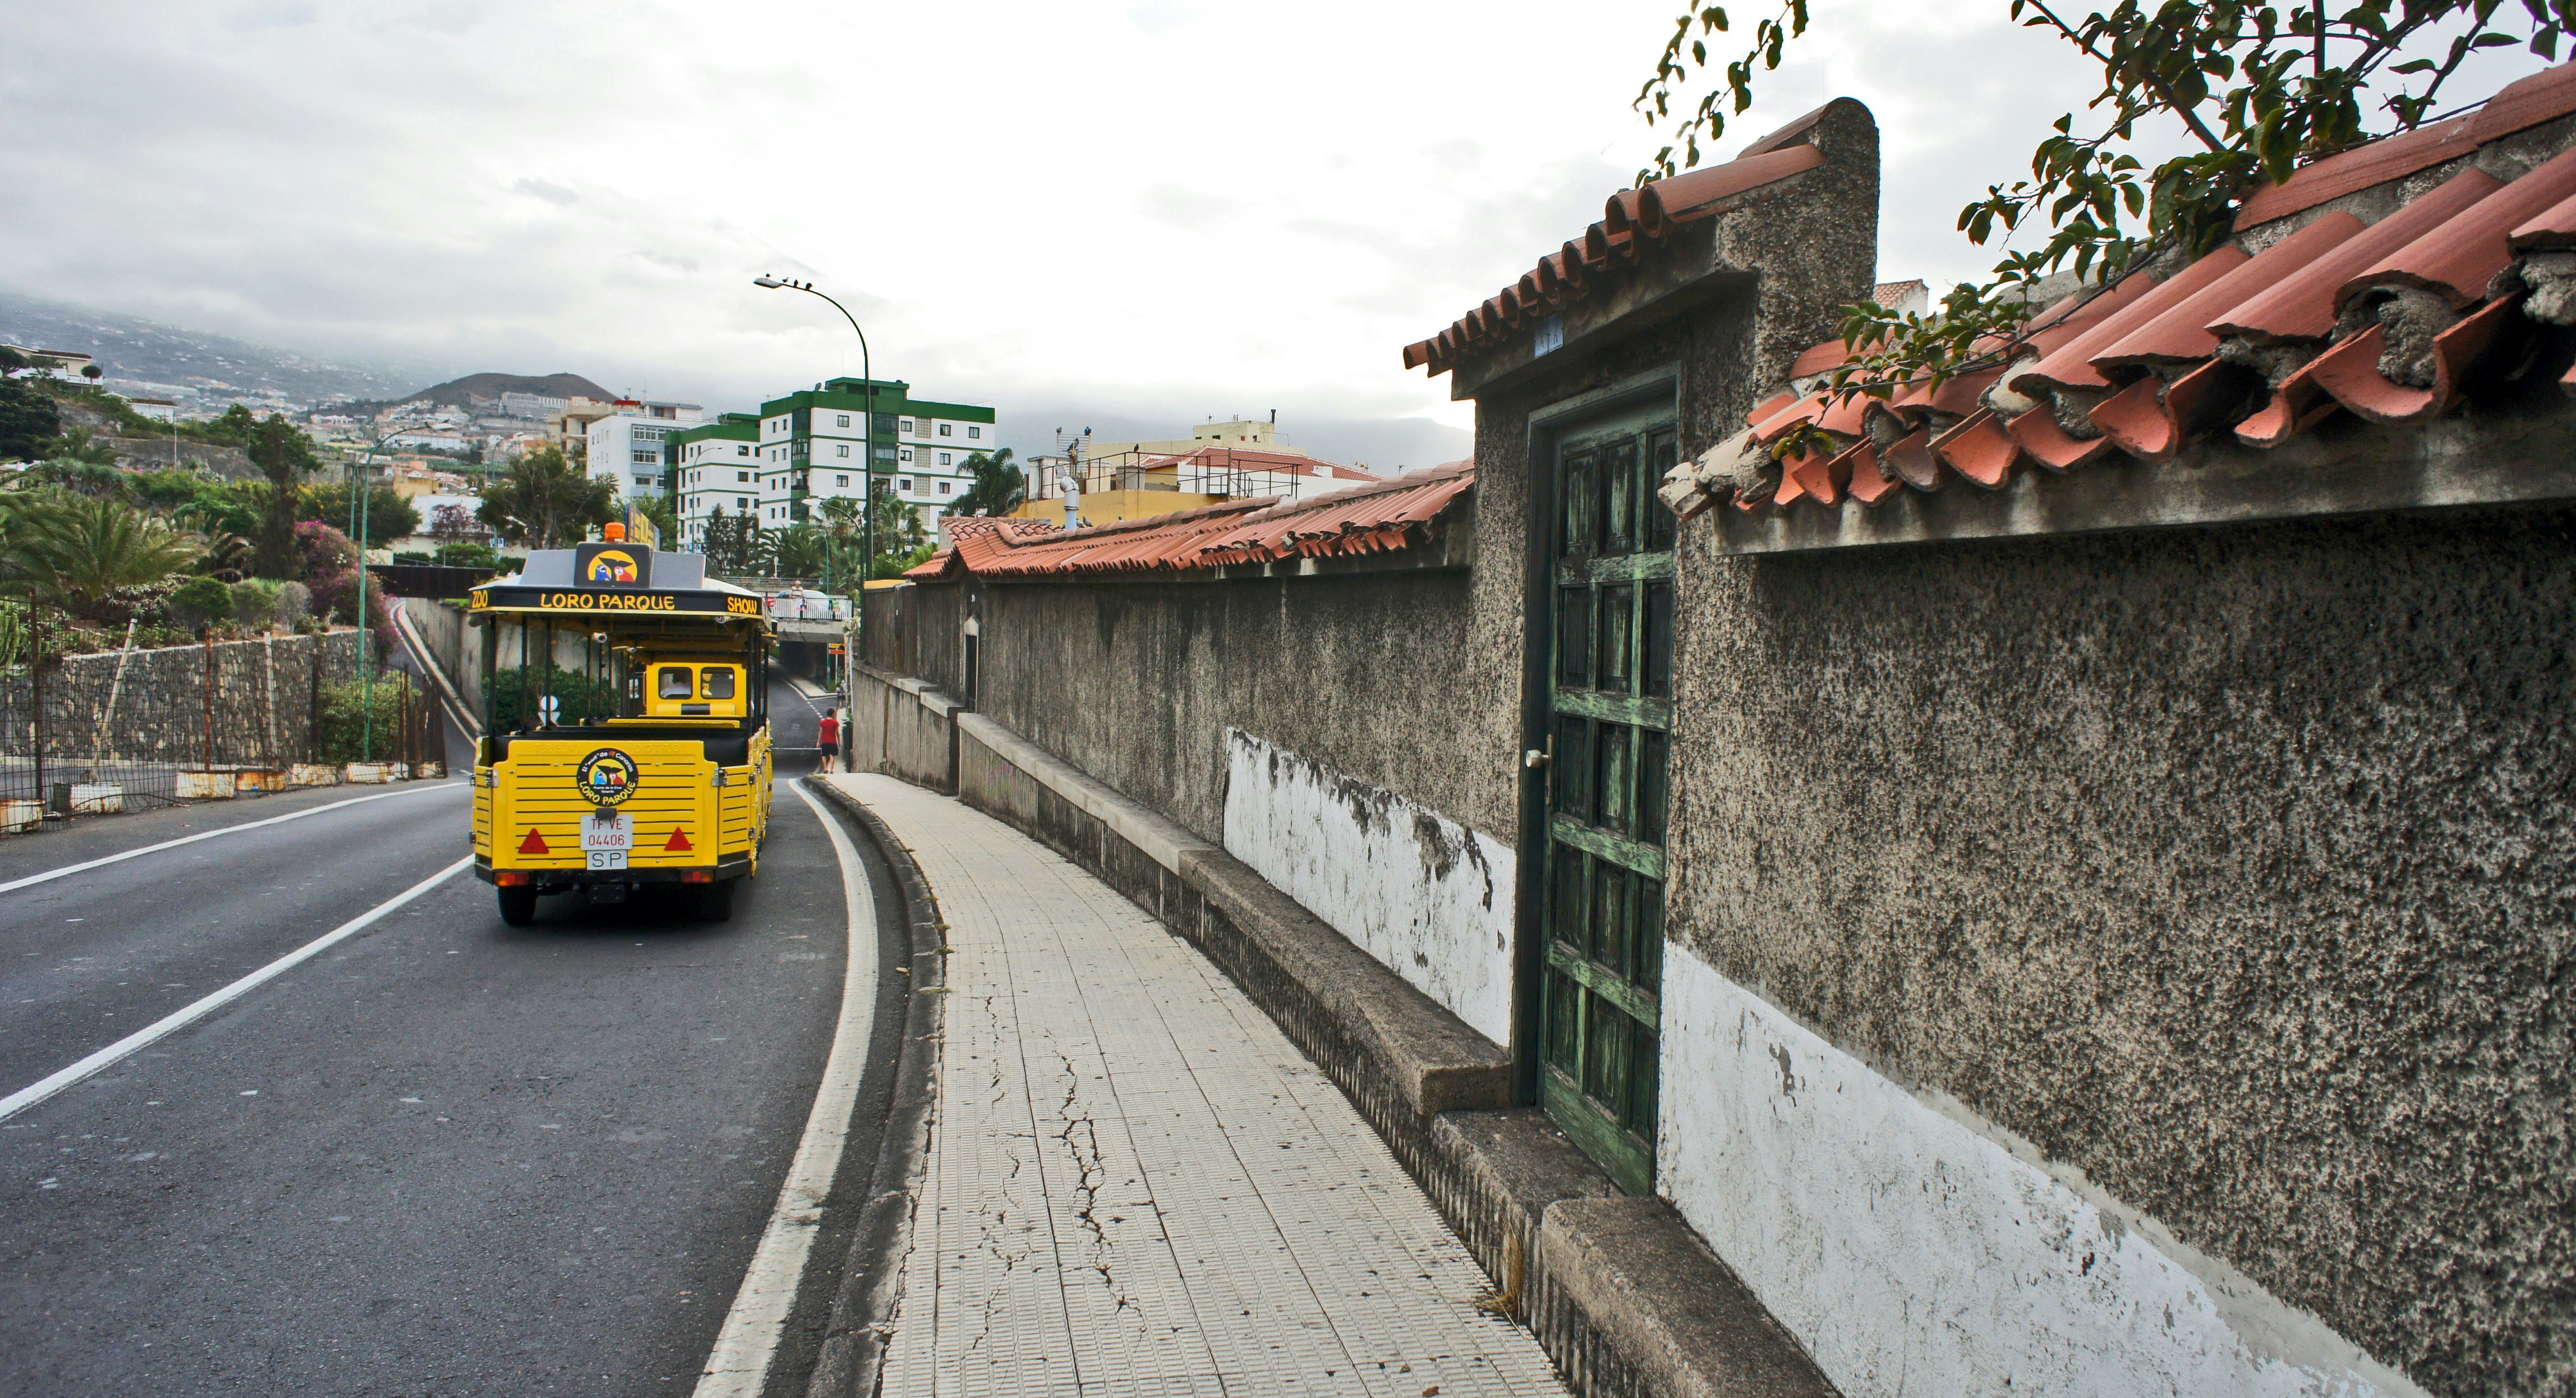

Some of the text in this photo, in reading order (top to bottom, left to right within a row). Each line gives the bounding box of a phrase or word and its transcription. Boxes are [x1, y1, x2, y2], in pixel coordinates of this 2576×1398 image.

[471, 590, 488, 608] ZOO
[541, 594, 675, 610] LORO PARQUE
[727, 596, 757, 614] SHOW
[615, 752, 633, 772] Canarias
[579, 781, 636, 805] LORO PARQUE
[591, 818, 623, 830] TF VE
[588, 835, 624, 846] 04406
